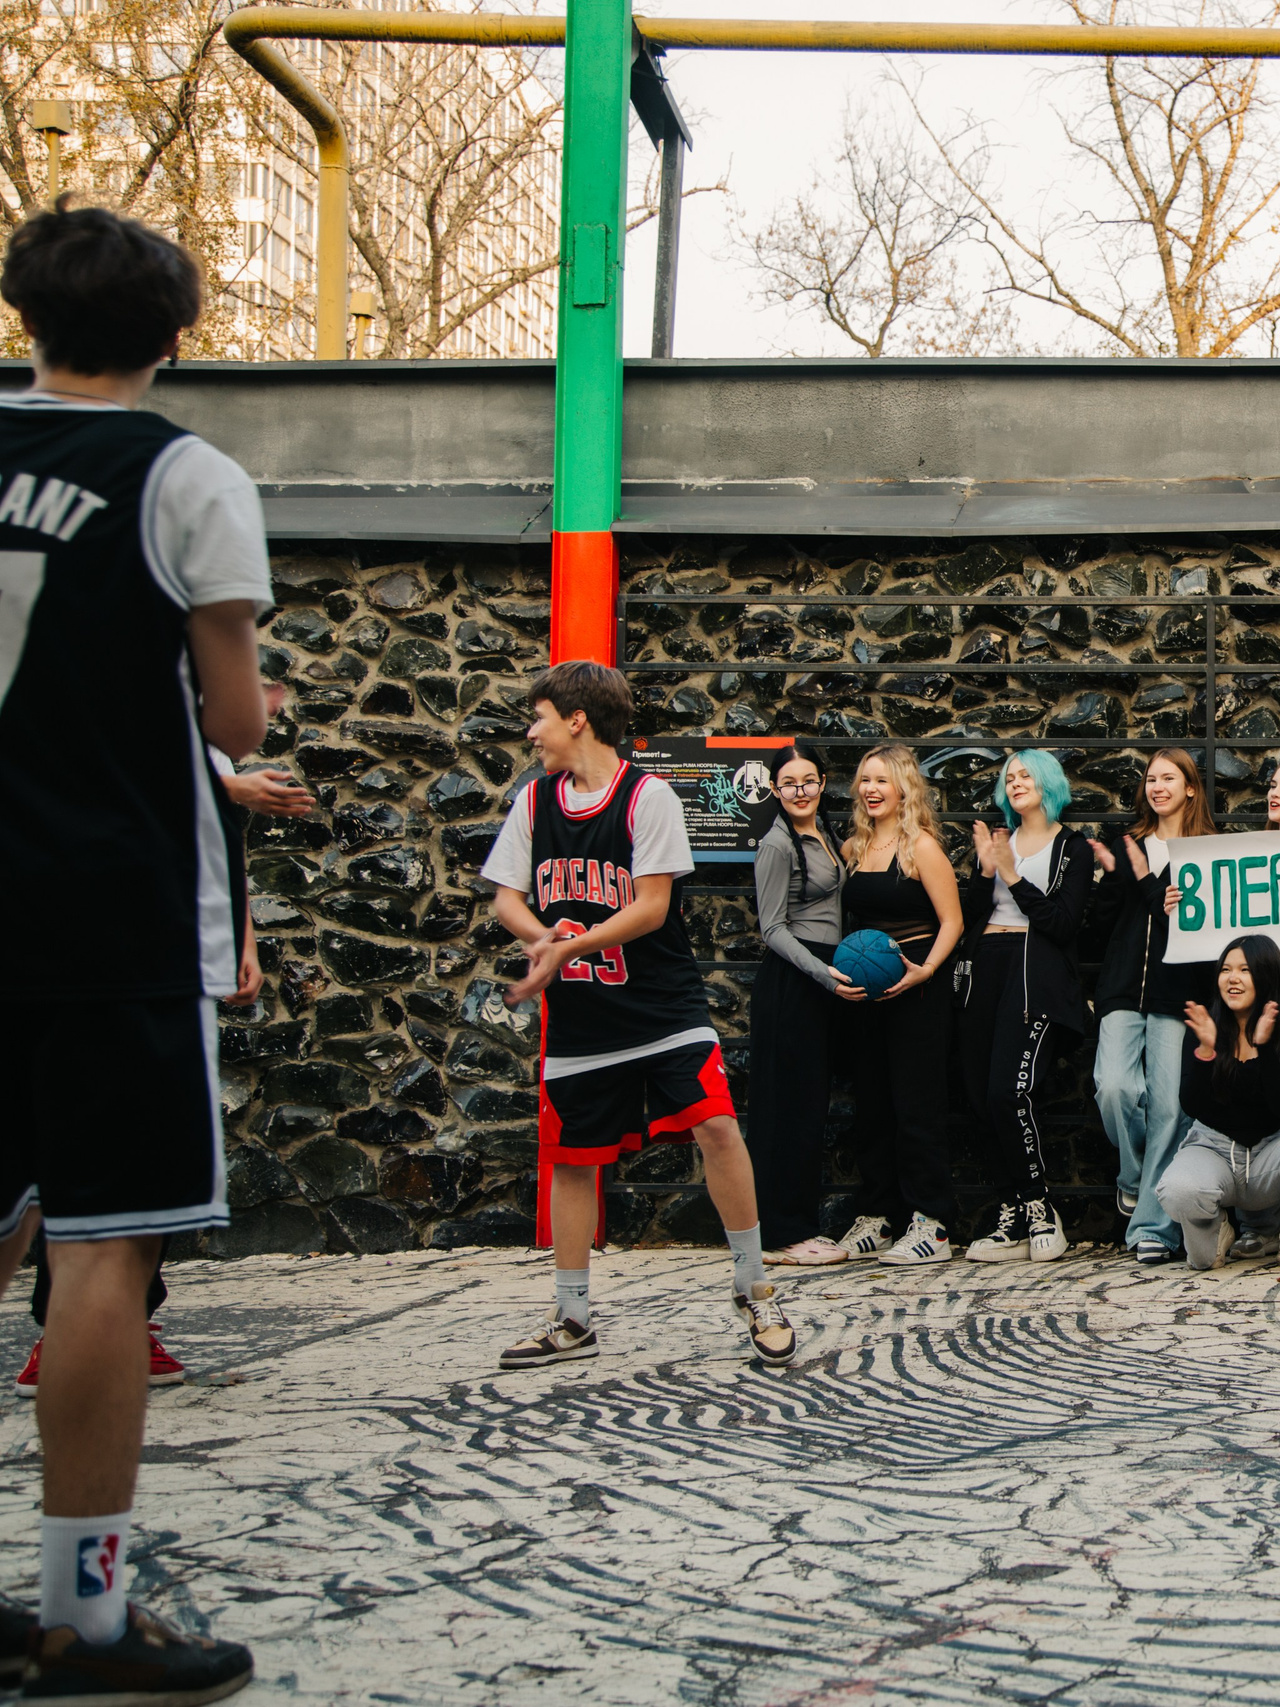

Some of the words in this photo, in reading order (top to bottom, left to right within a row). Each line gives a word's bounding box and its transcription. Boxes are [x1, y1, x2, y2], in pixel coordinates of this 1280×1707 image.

[0, 472, 109, 542] ANT
[632, 750, 660, 758] Привет!
[536, 857, 635, 912] CHICAGO
[1016, 1108, 1035, 1154] BLACK
